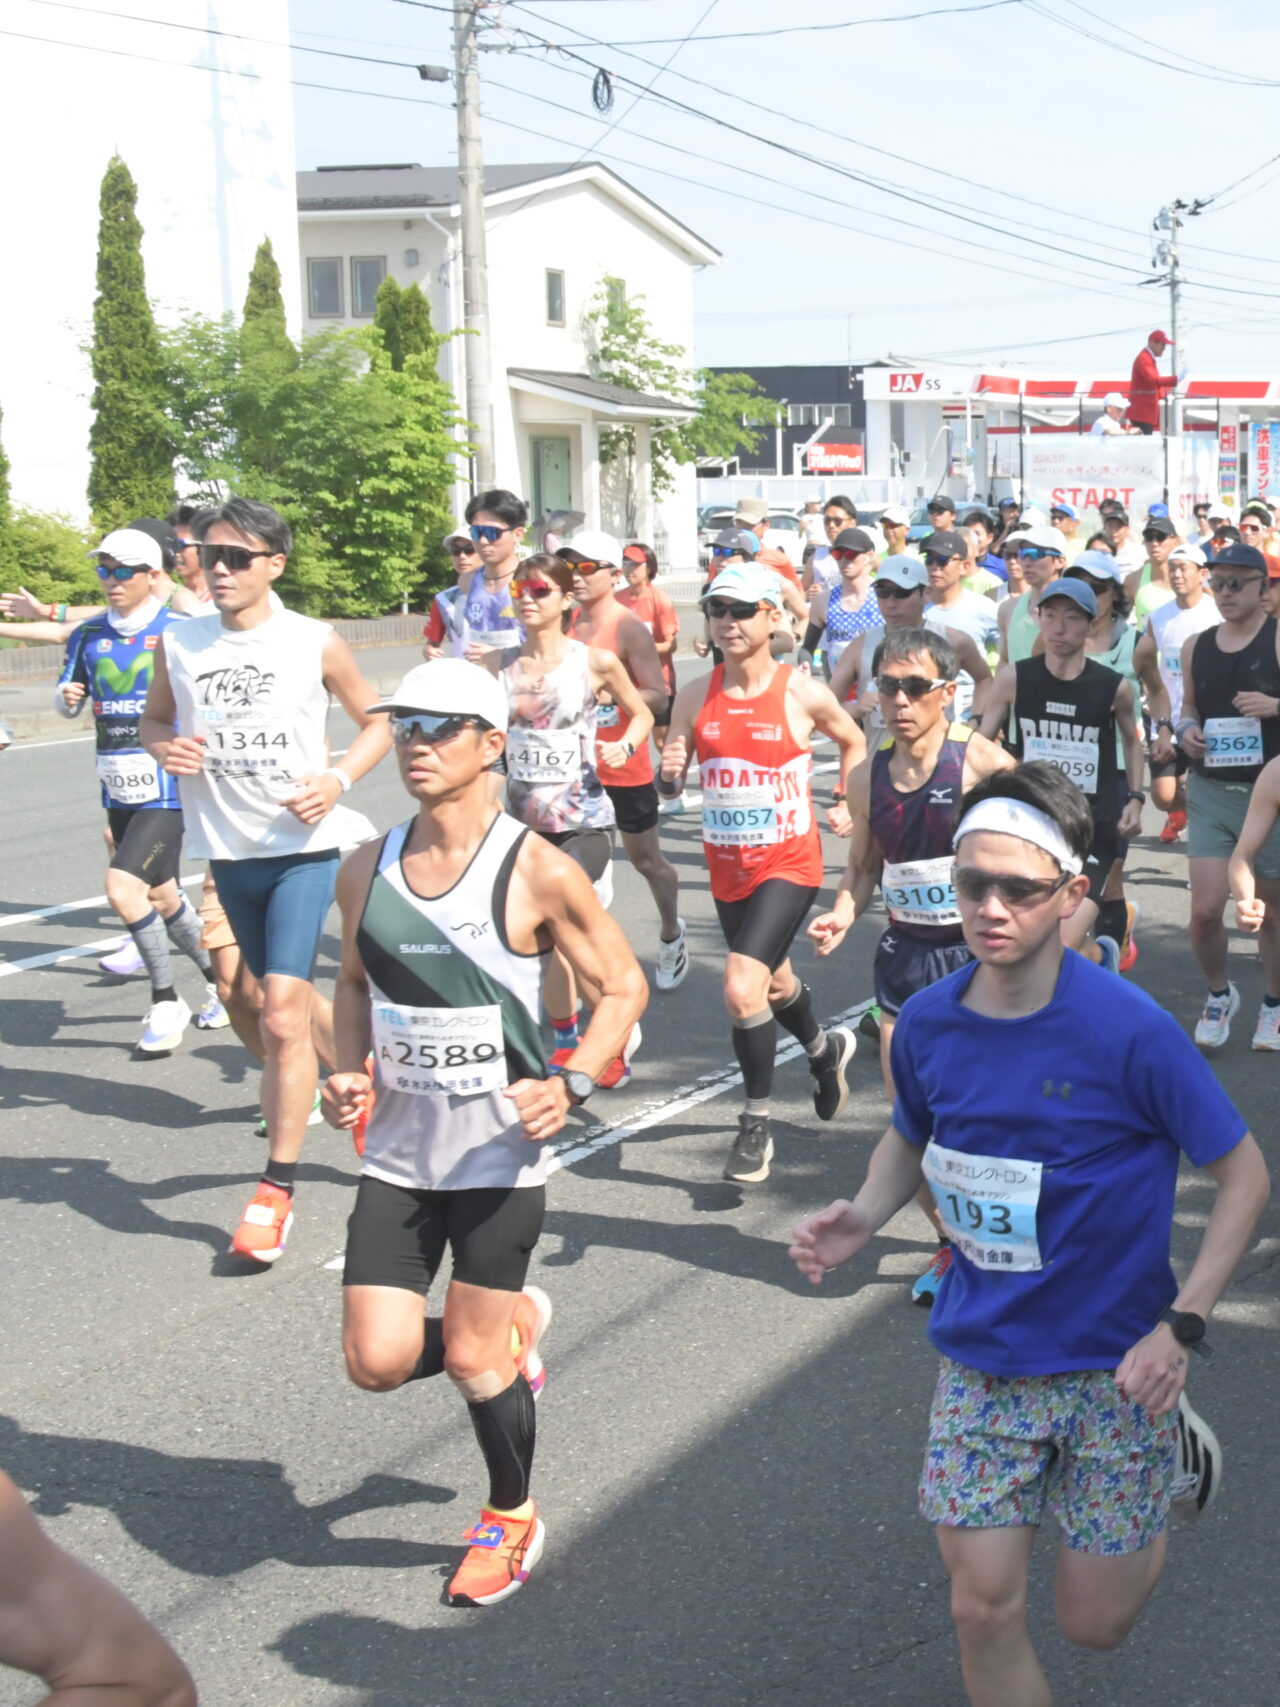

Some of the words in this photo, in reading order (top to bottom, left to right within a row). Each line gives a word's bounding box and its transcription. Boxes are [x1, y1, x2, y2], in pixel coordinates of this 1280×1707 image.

[891, 374, 918, 392] JA
[1046, 701, 1077, 717] SHONAN
[1209, 735, 1260, 752] 2562
[400, 943, 452, 955] SAURUS
[380, 1008, 406, 1026] TEL
[945, 1160, 1027, 1184] 東京エレクトロン
[946, 1194, 1013, 1235] 193
